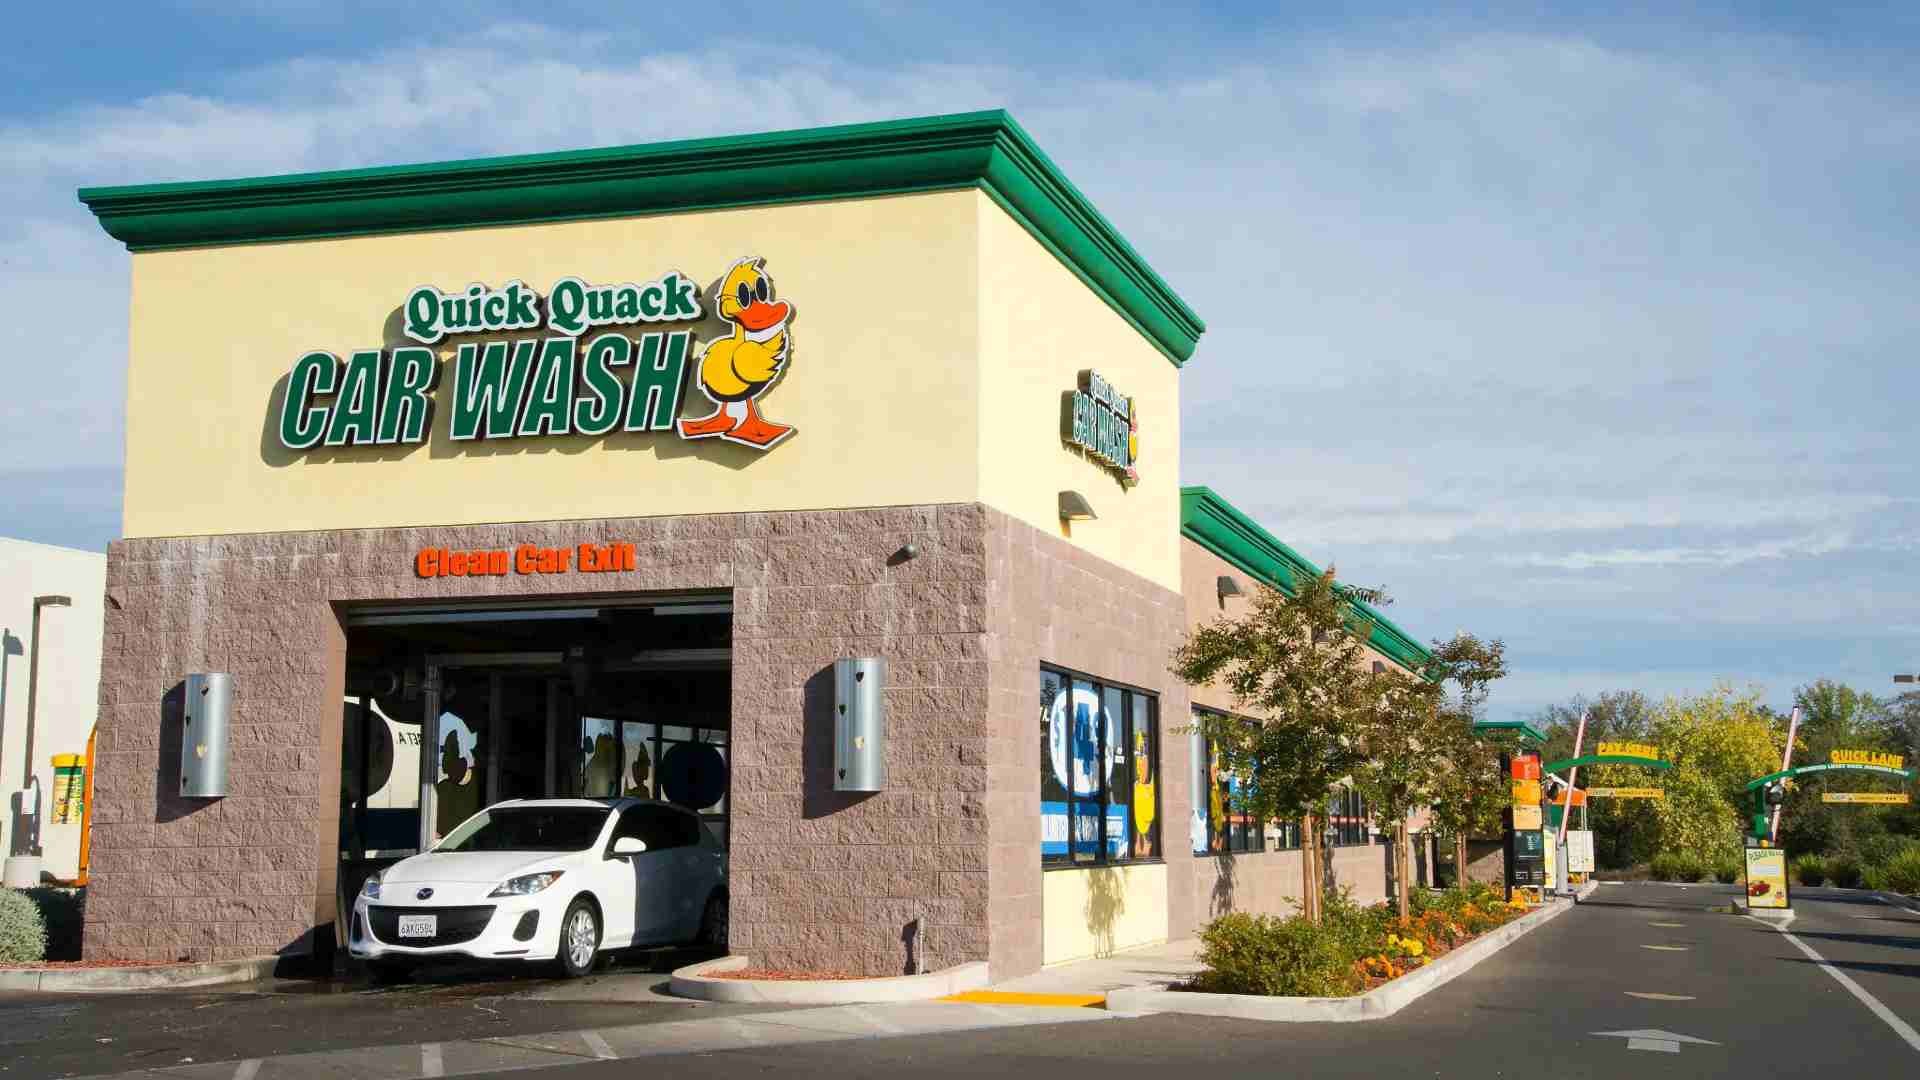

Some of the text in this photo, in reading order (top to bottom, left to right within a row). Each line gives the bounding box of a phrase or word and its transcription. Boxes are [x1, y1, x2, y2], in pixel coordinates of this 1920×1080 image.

[405, 271, 700, 342] Quick Quack
[280, 331, 694, 448] CAR WASH
[1073, 389, 1097, 450] CAR
[417, 541, 636, 577] Clean Car Exit
[1831, 750, 1904, 768] QUICK LANE
